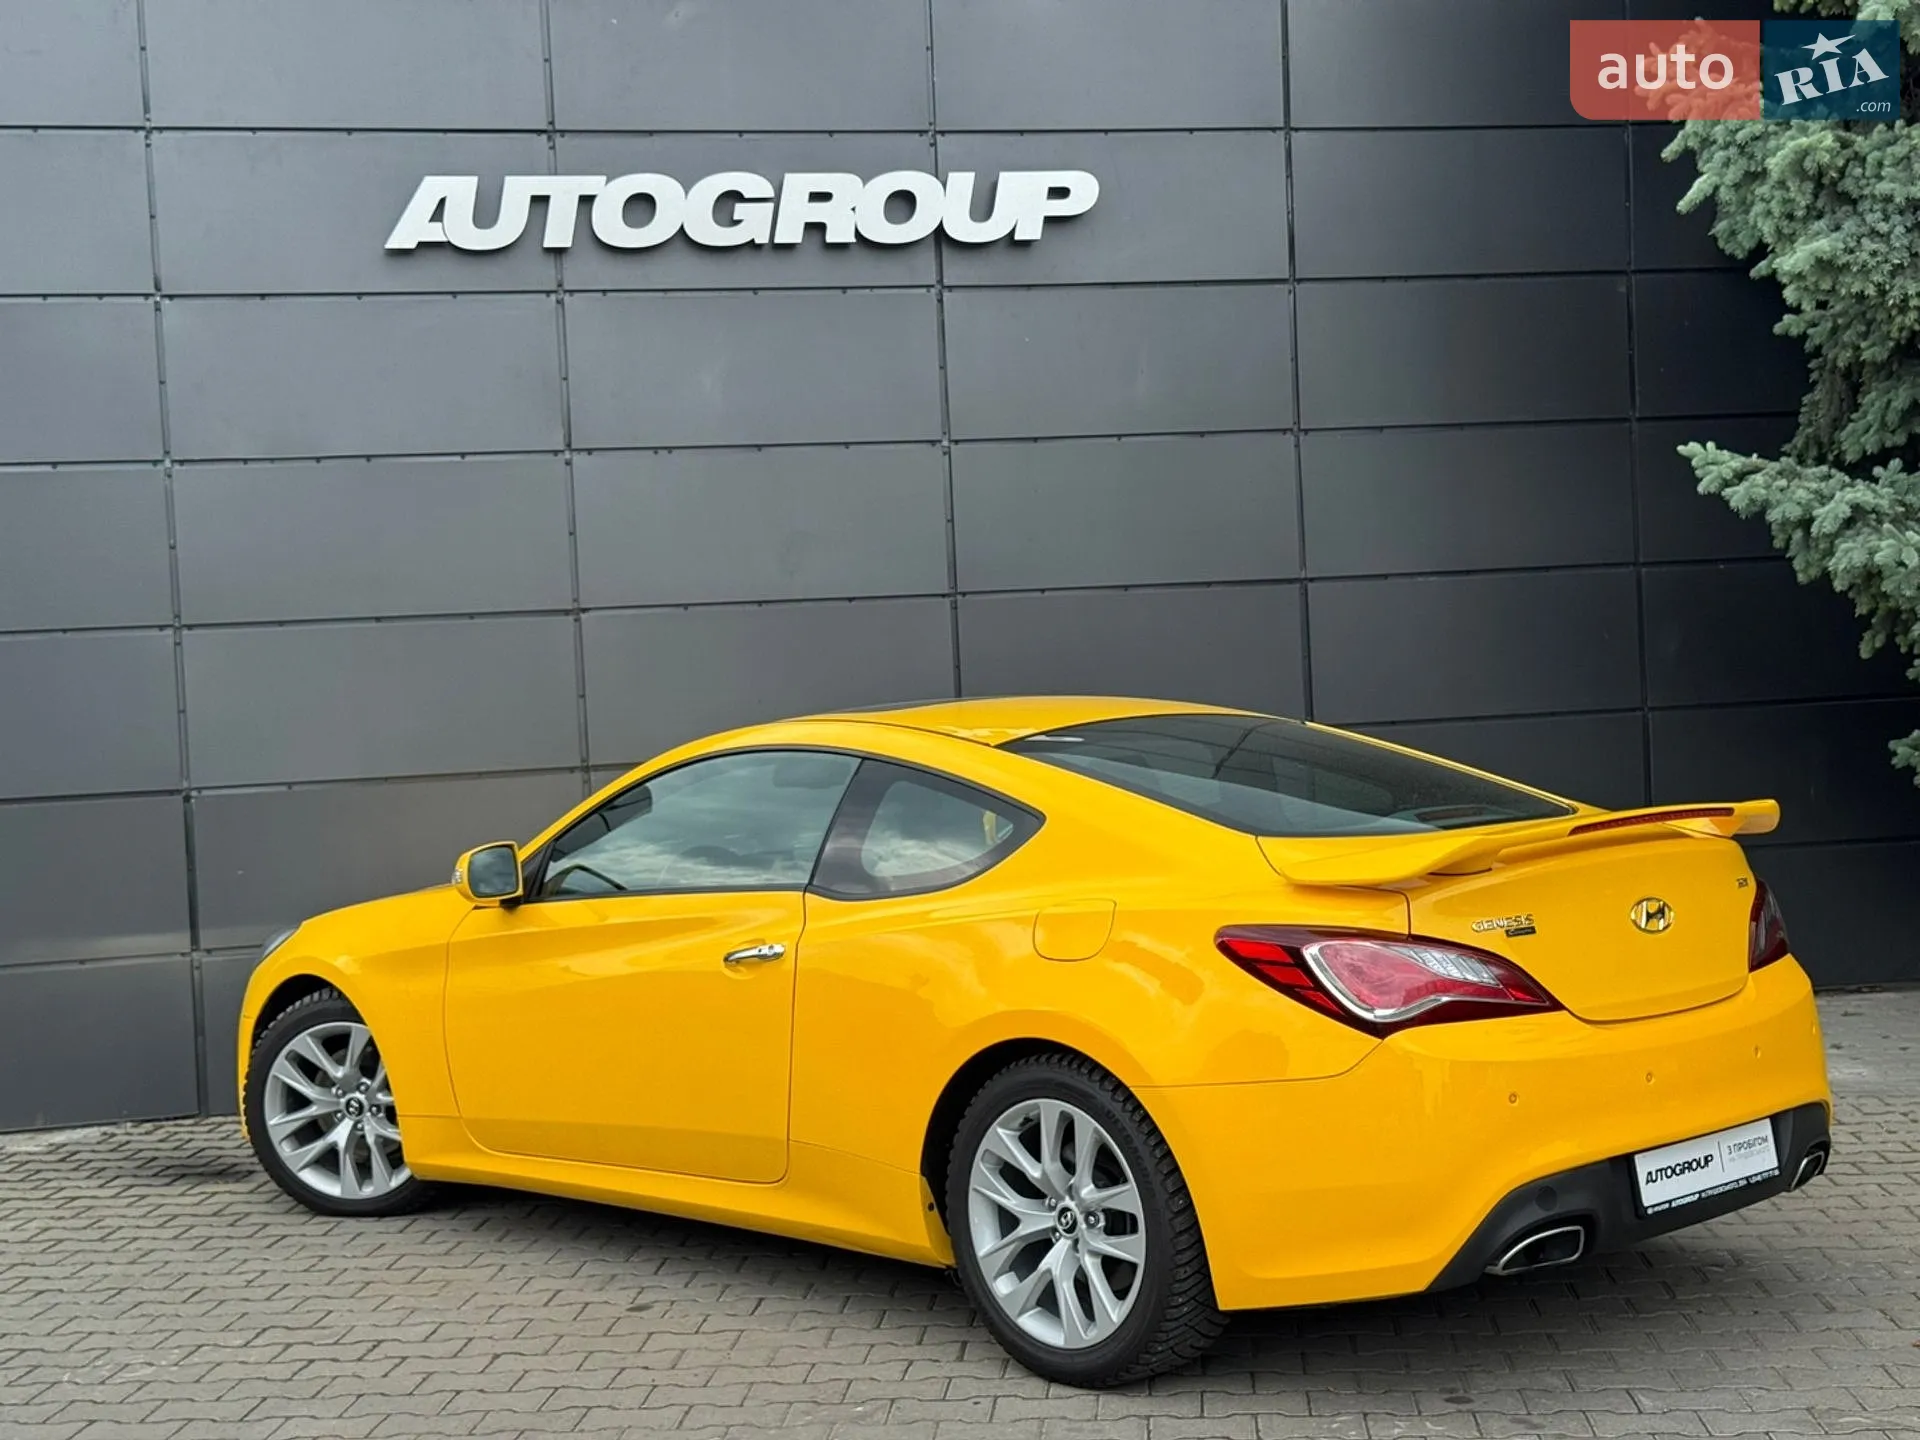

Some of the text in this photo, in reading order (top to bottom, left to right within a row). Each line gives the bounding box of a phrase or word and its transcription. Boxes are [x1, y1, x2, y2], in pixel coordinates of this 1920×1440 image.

[384, 170, 1101, 251] AUTOGROUP
[1471, 914, 1535, 932] GENESIS
[1645, 1154, 1714, 1186] AUTOGROUP
